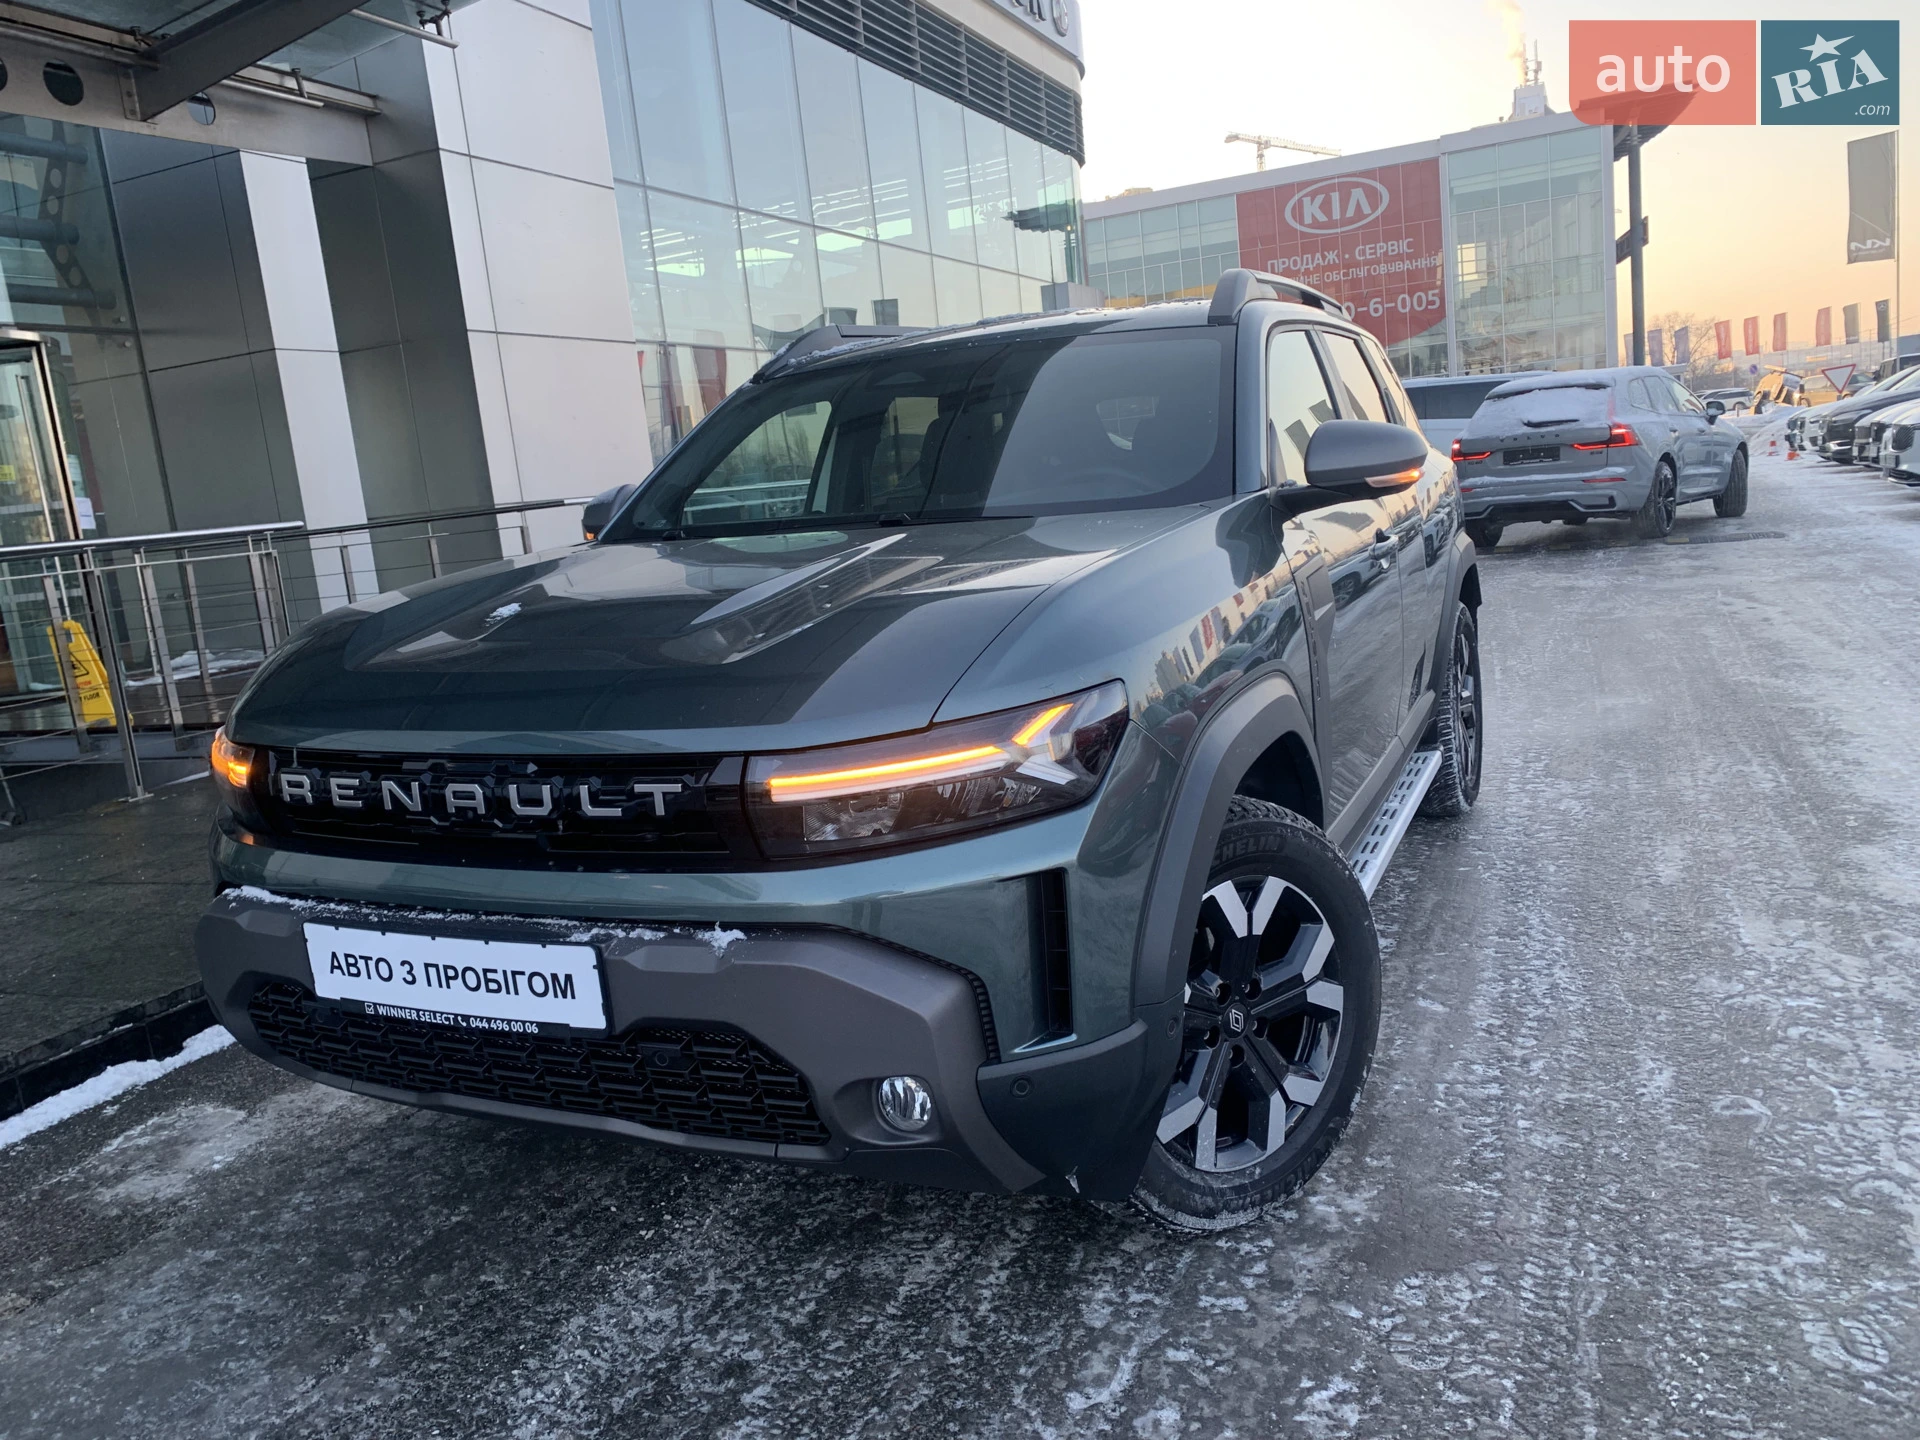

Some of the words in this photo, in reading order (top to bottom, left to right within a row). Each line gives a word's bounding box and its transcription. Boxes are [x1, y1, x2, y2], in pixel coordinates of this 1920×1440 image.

[1302, 188, 1373, 225] KIA
[1267, 250, 1340, 274] ПРОДАЖ
[1355, 238, 1414, 260] СЕРВІС
[1324, 256, 1439, 283] ОБСЛУГОВУВАННЯ
[279, 772, 683, 817] RENAULT
[329, 950, 394, 983] АВТО
[424, 962, 577, 1000] ПРОБІГОМ
[376, 1004, 419, 1021] WINNER
[419, 1010, 455, 1026] SELECT
[469, 1016, 489, 1030] 044
[490, 1018, 510, 1032] 496
[511, 1020, 524, 1033] 00
[525, 1022, 539, 1035] 06
